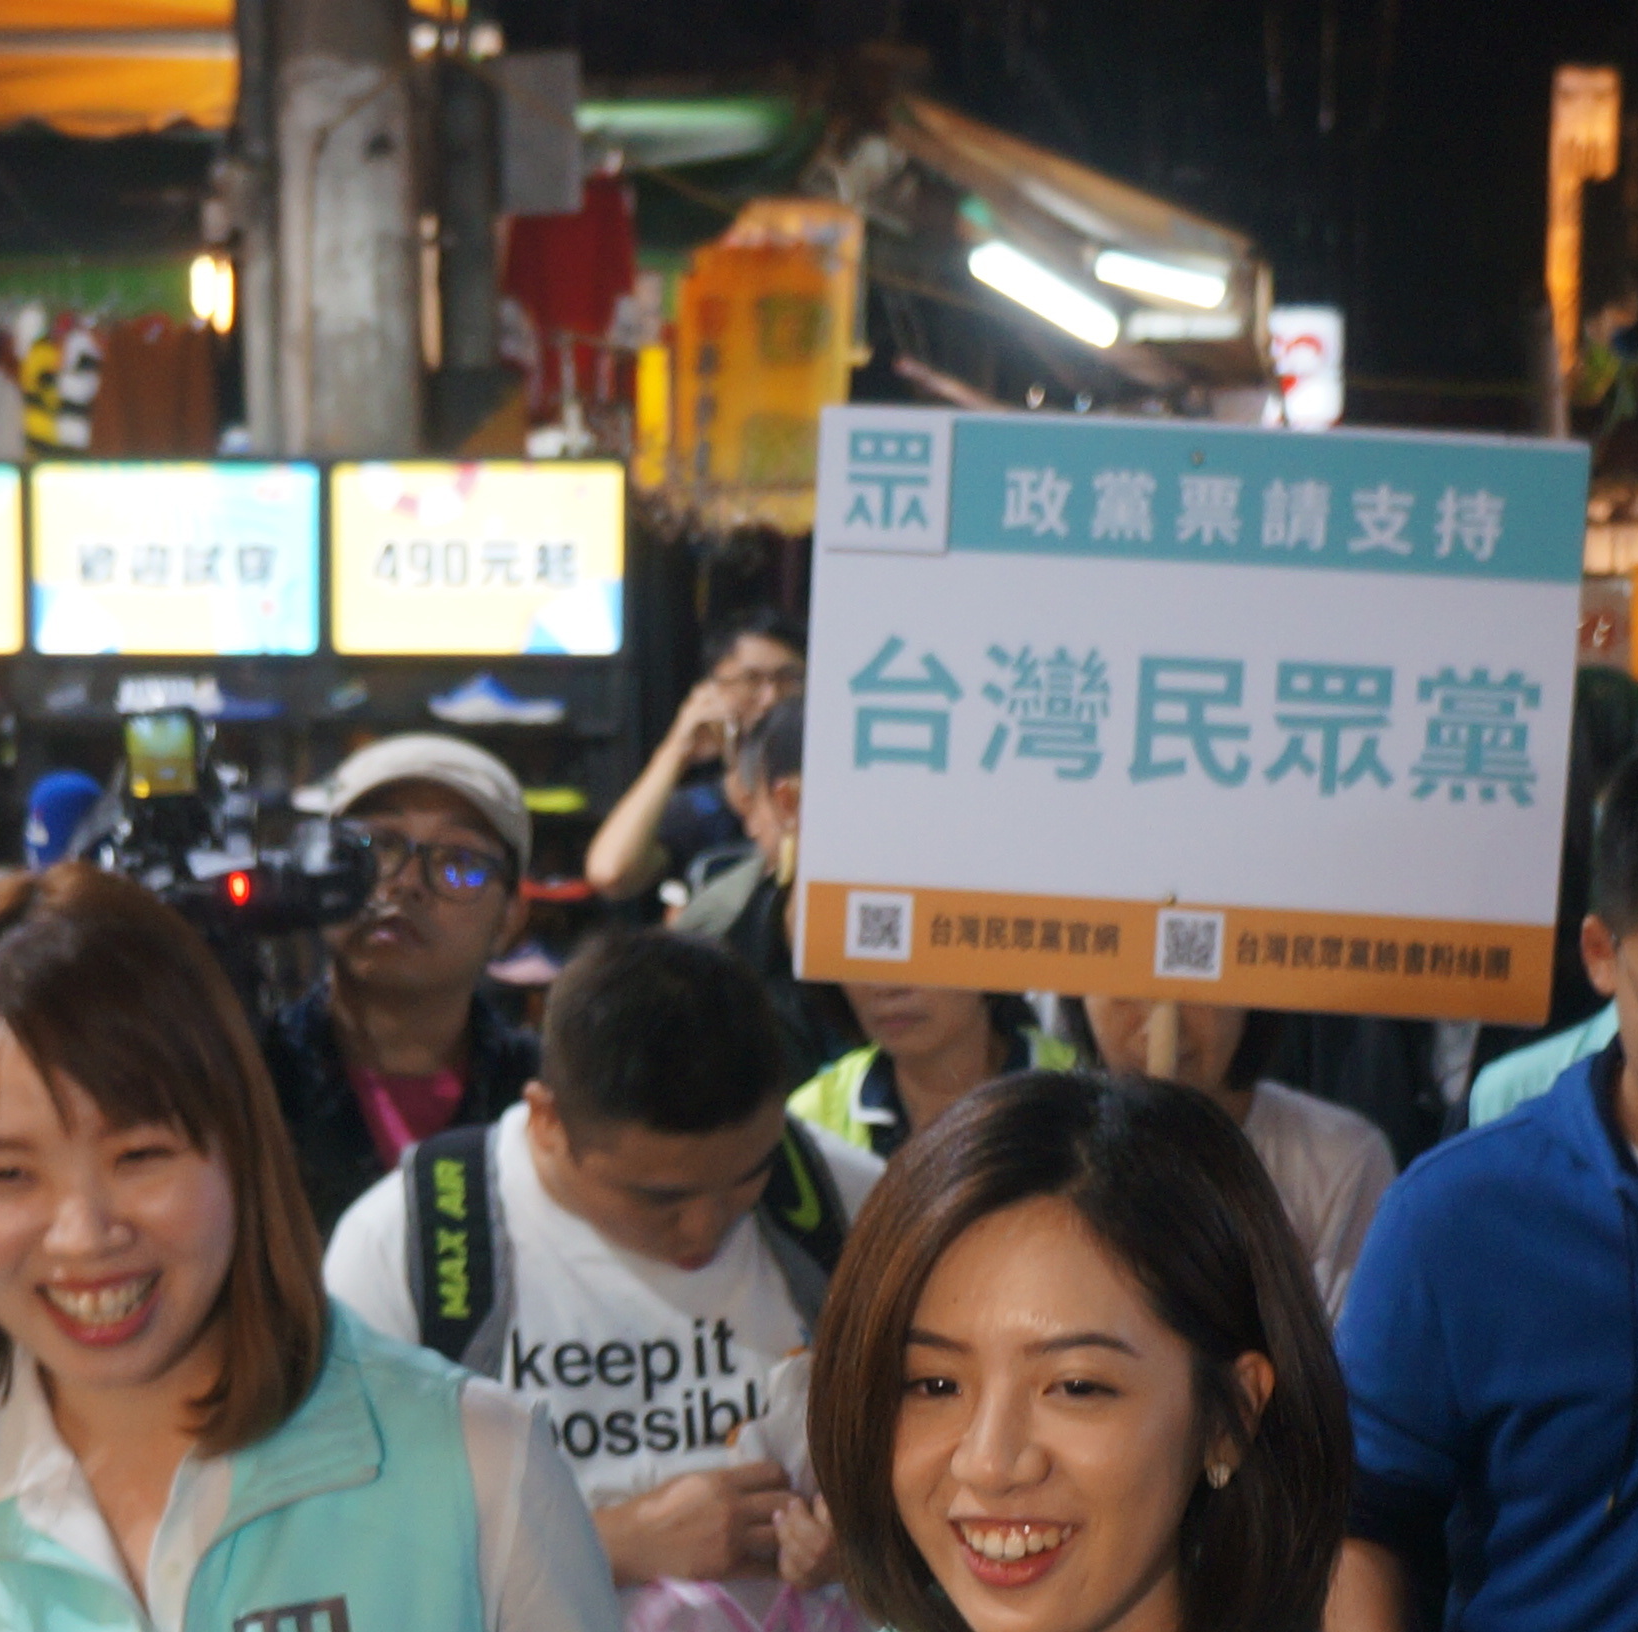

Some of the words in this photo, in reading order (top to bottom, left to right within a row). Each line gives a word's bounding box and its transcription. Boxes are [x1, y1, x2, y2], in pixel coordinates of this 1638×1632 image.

[845, 430, 931, 532] 眾
[1003, 466, 1505, 562] 政黨票請支持
[847, 635, 1543, 808] 台灣民眾黨
[432, 1159, 467, 1222] AIR
[436, 1230, 470, 1319] MAX
[511, 1329, 681, 1402] keep
[692, 1317, 737, 1379] it
[553, 1382, 769, 1460] ossibl
